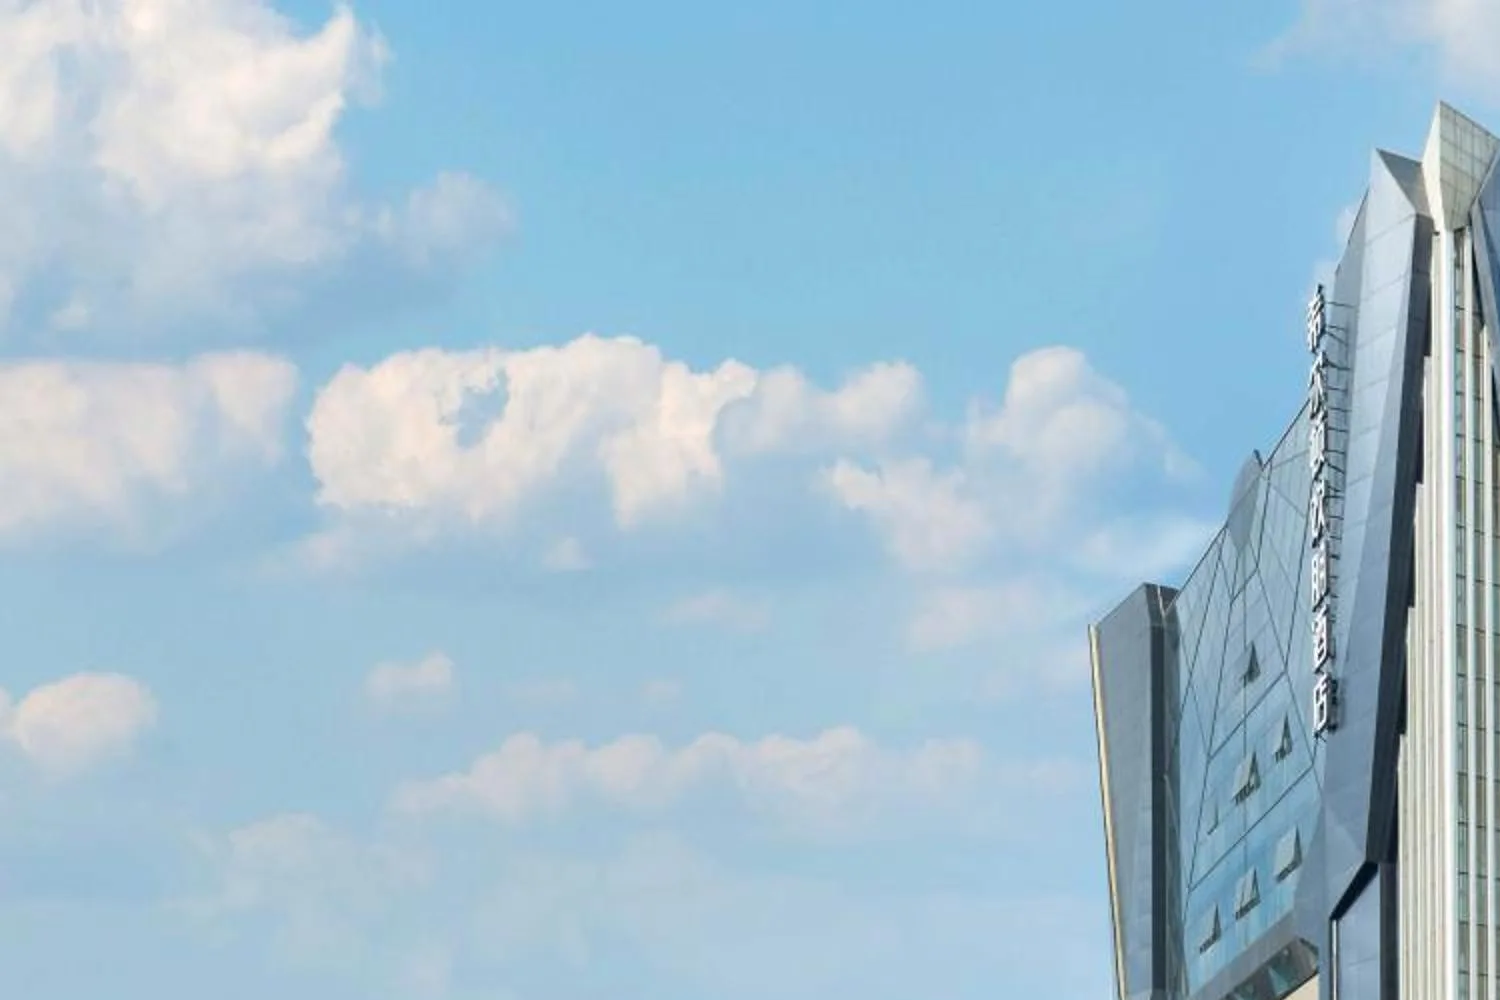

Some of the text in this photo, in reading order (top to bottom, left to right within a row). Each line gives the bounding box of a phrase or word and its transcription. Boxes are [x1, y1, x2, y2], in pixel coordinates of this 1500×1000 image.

[1306, 284, 1328, 732] 希尔顿欢朋酒店
